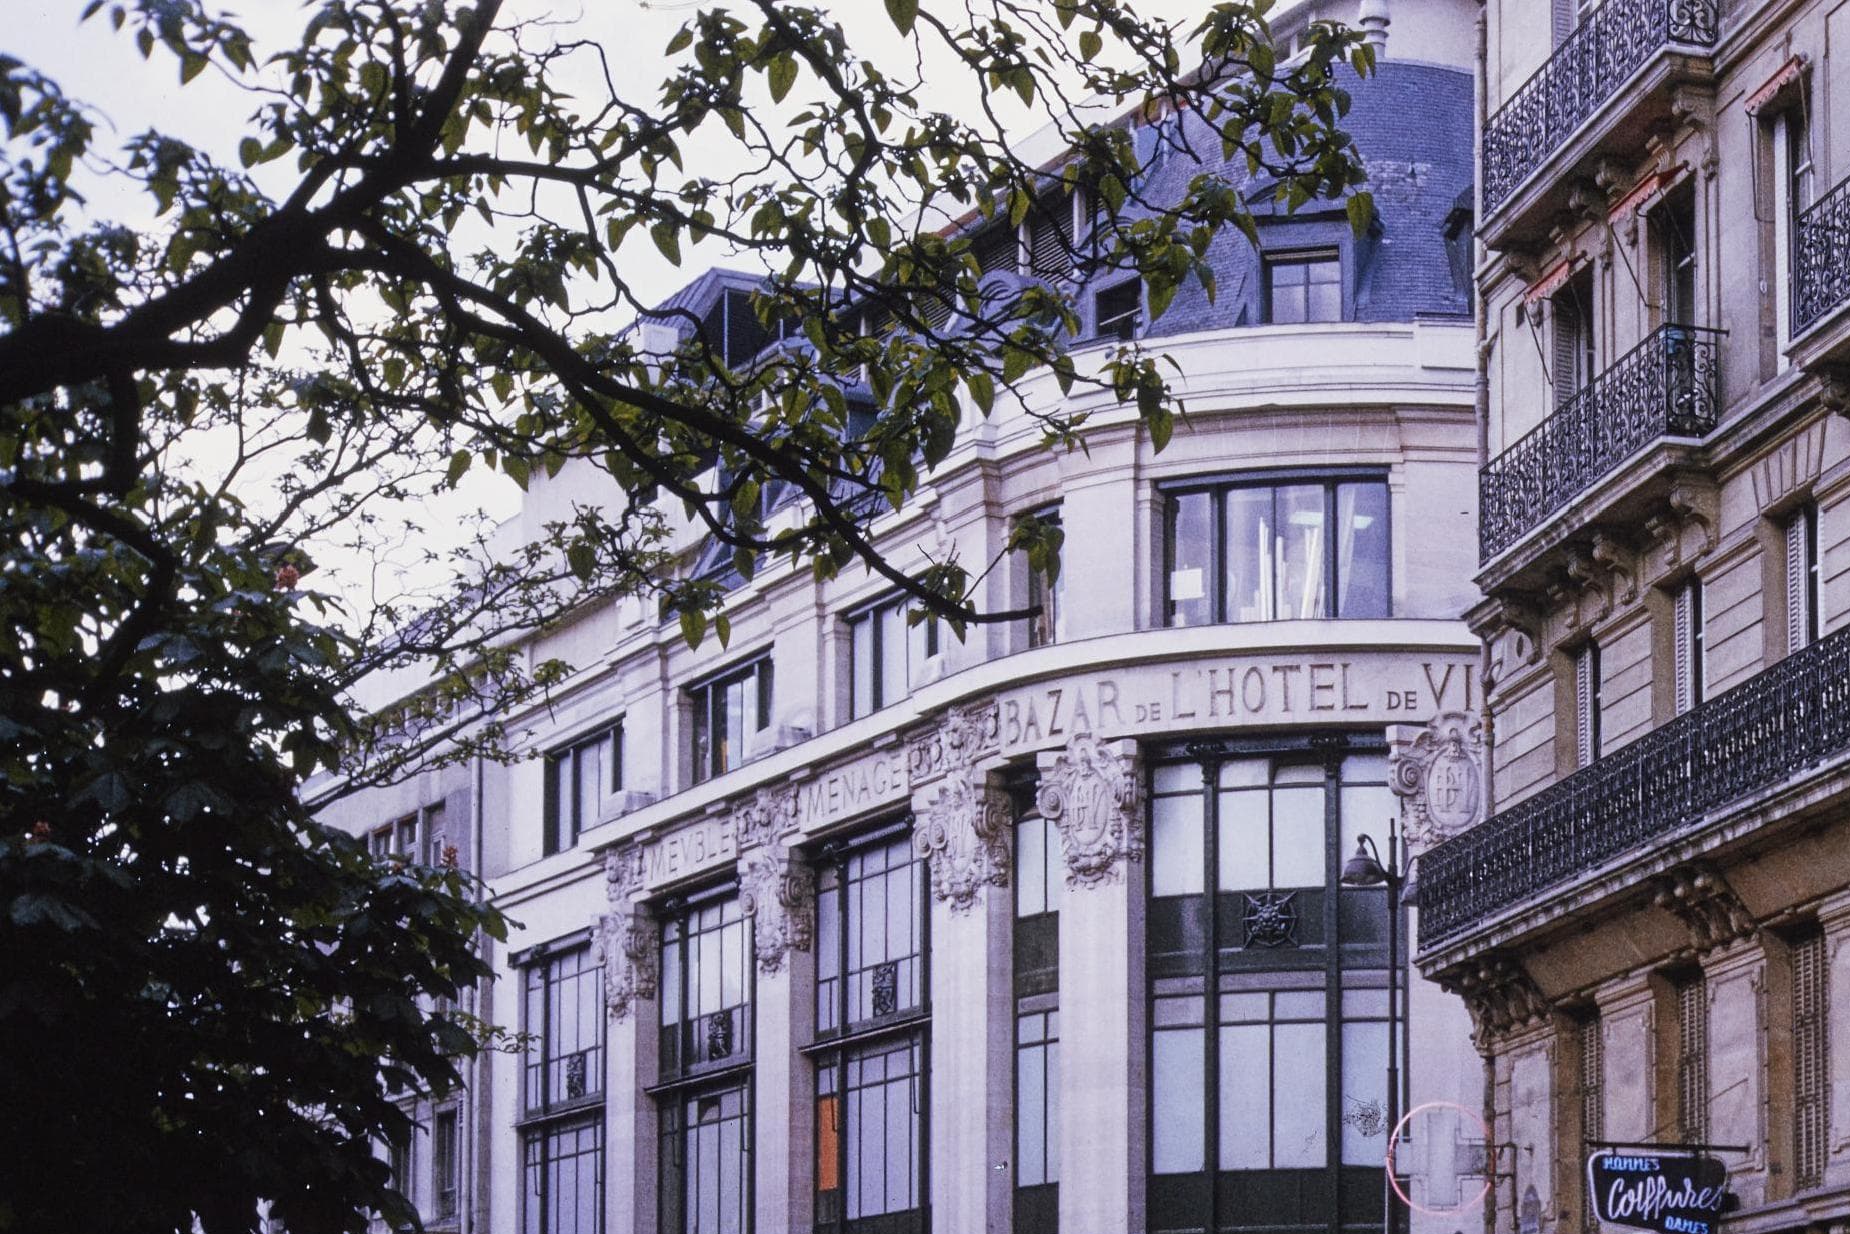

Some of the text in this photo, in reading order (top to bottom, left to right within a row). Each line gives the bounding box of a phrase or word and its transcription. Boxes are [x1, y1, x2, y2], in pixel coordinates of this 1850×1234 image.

[1005, 680, 1126, 747] BAZAR
[1135, 701, 1161, 724] DE
[1172, 663, 1369, 720] L'HOTEL
[1386, 690, 1418, 711] DE
